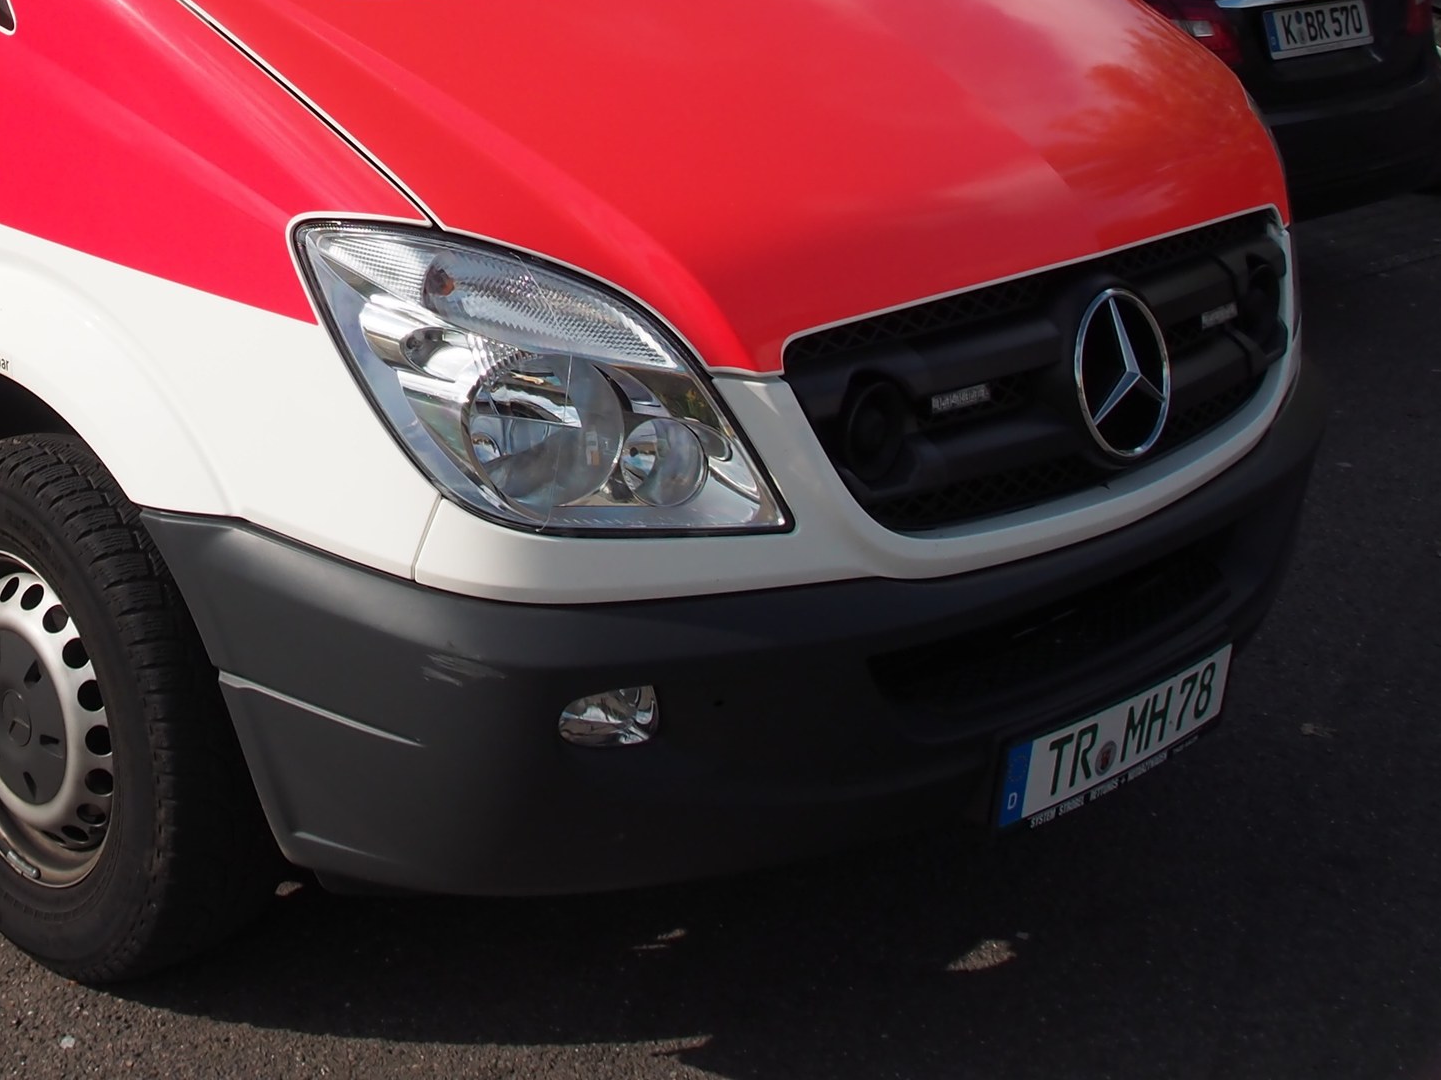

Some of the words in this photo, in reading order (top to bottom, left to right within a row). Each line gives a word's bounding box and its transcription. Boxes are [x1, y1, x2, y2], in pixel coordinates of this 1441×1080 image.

[1281, 14, 1297, 45] K
[1304, 9, 1330, 42] BR
[1330, 4, 1362, 37] 570
[1049, 723, 1098, 796] TR
[1120, 686, 1173, 763] MH
[1176, 662, 1216, 731] 78
[1006, 792, 1018, 810] D
[1030, 806, 1056, 829] SYSTEM
